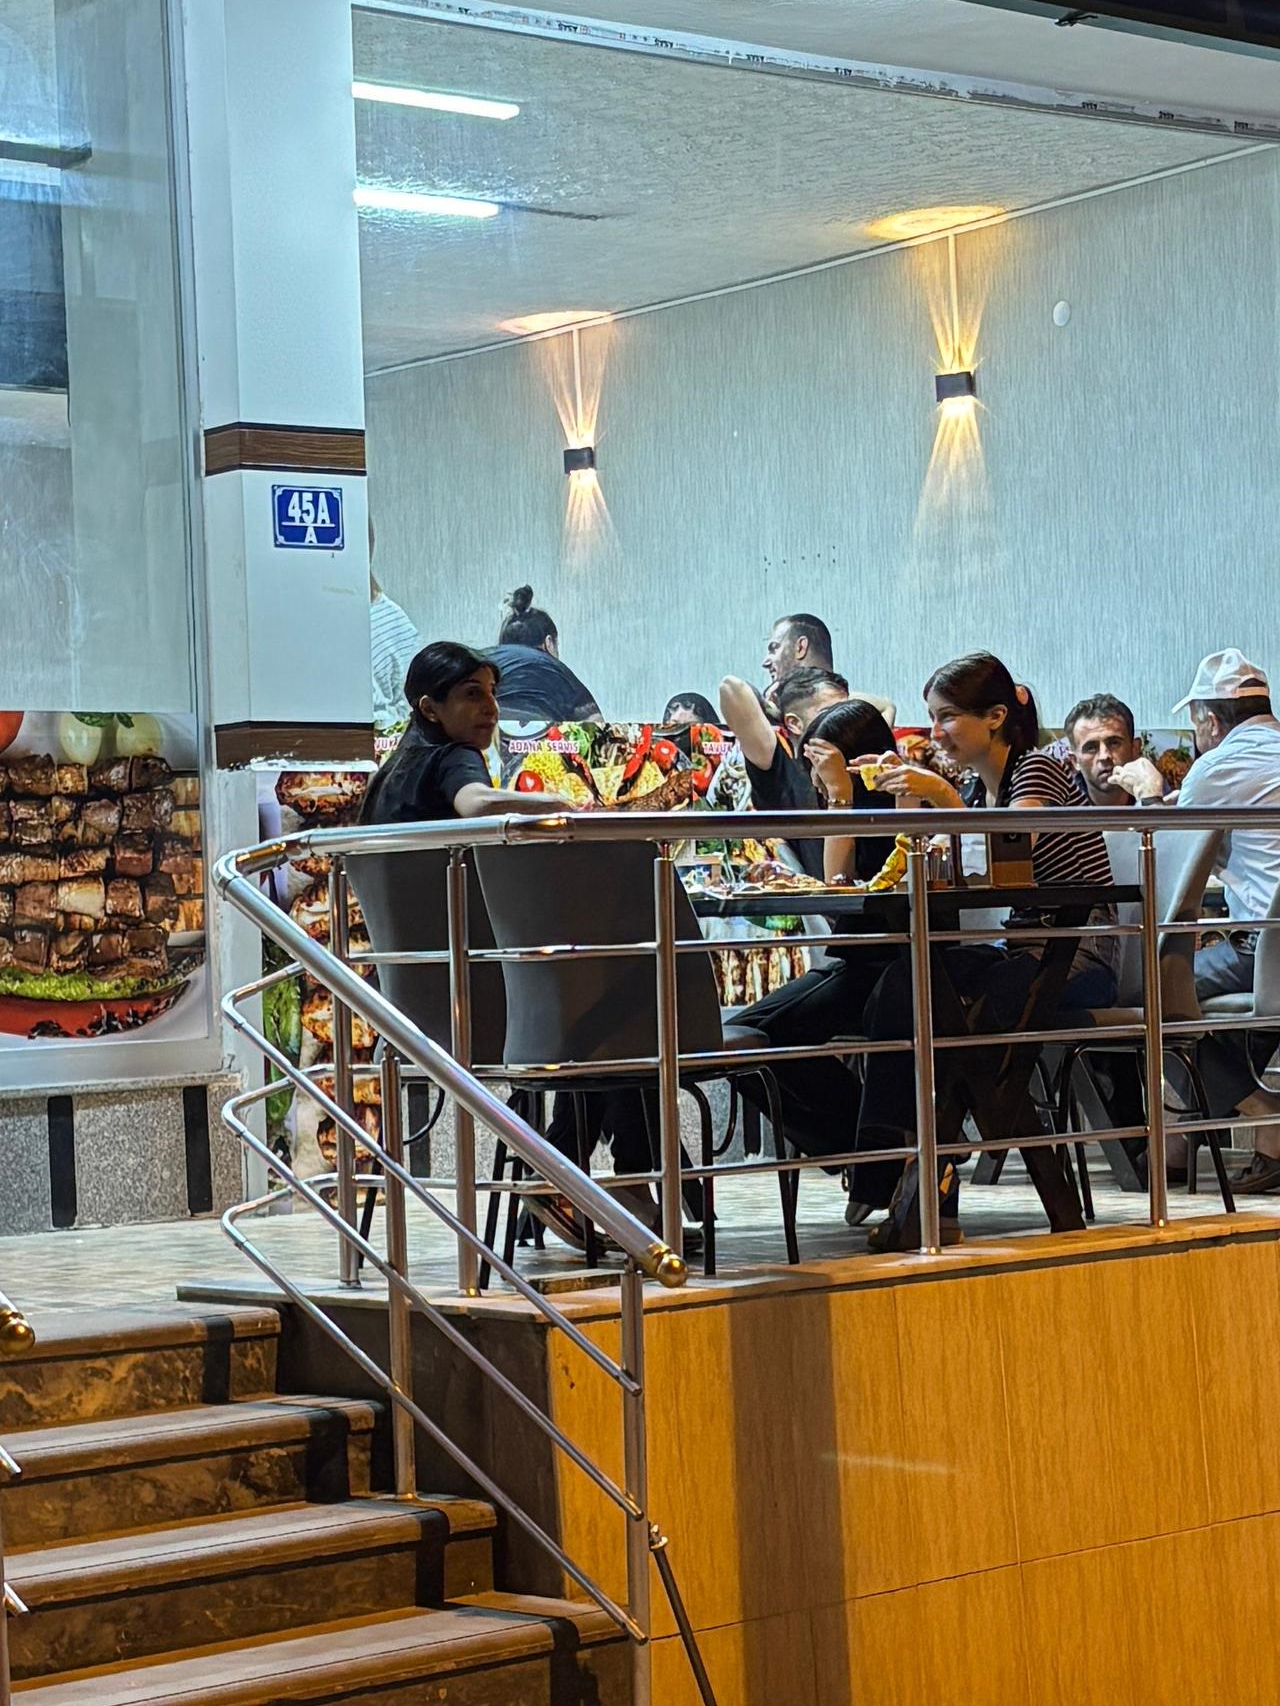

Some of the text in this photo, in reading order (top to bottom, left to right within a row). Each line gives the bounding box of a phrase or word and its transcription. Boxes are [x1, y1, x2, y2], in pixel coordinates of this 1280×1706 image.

[287, 491, 331, 525] 45A
[304, 526, 318, 544] A
[508, 739, 542, 753] ADANA
